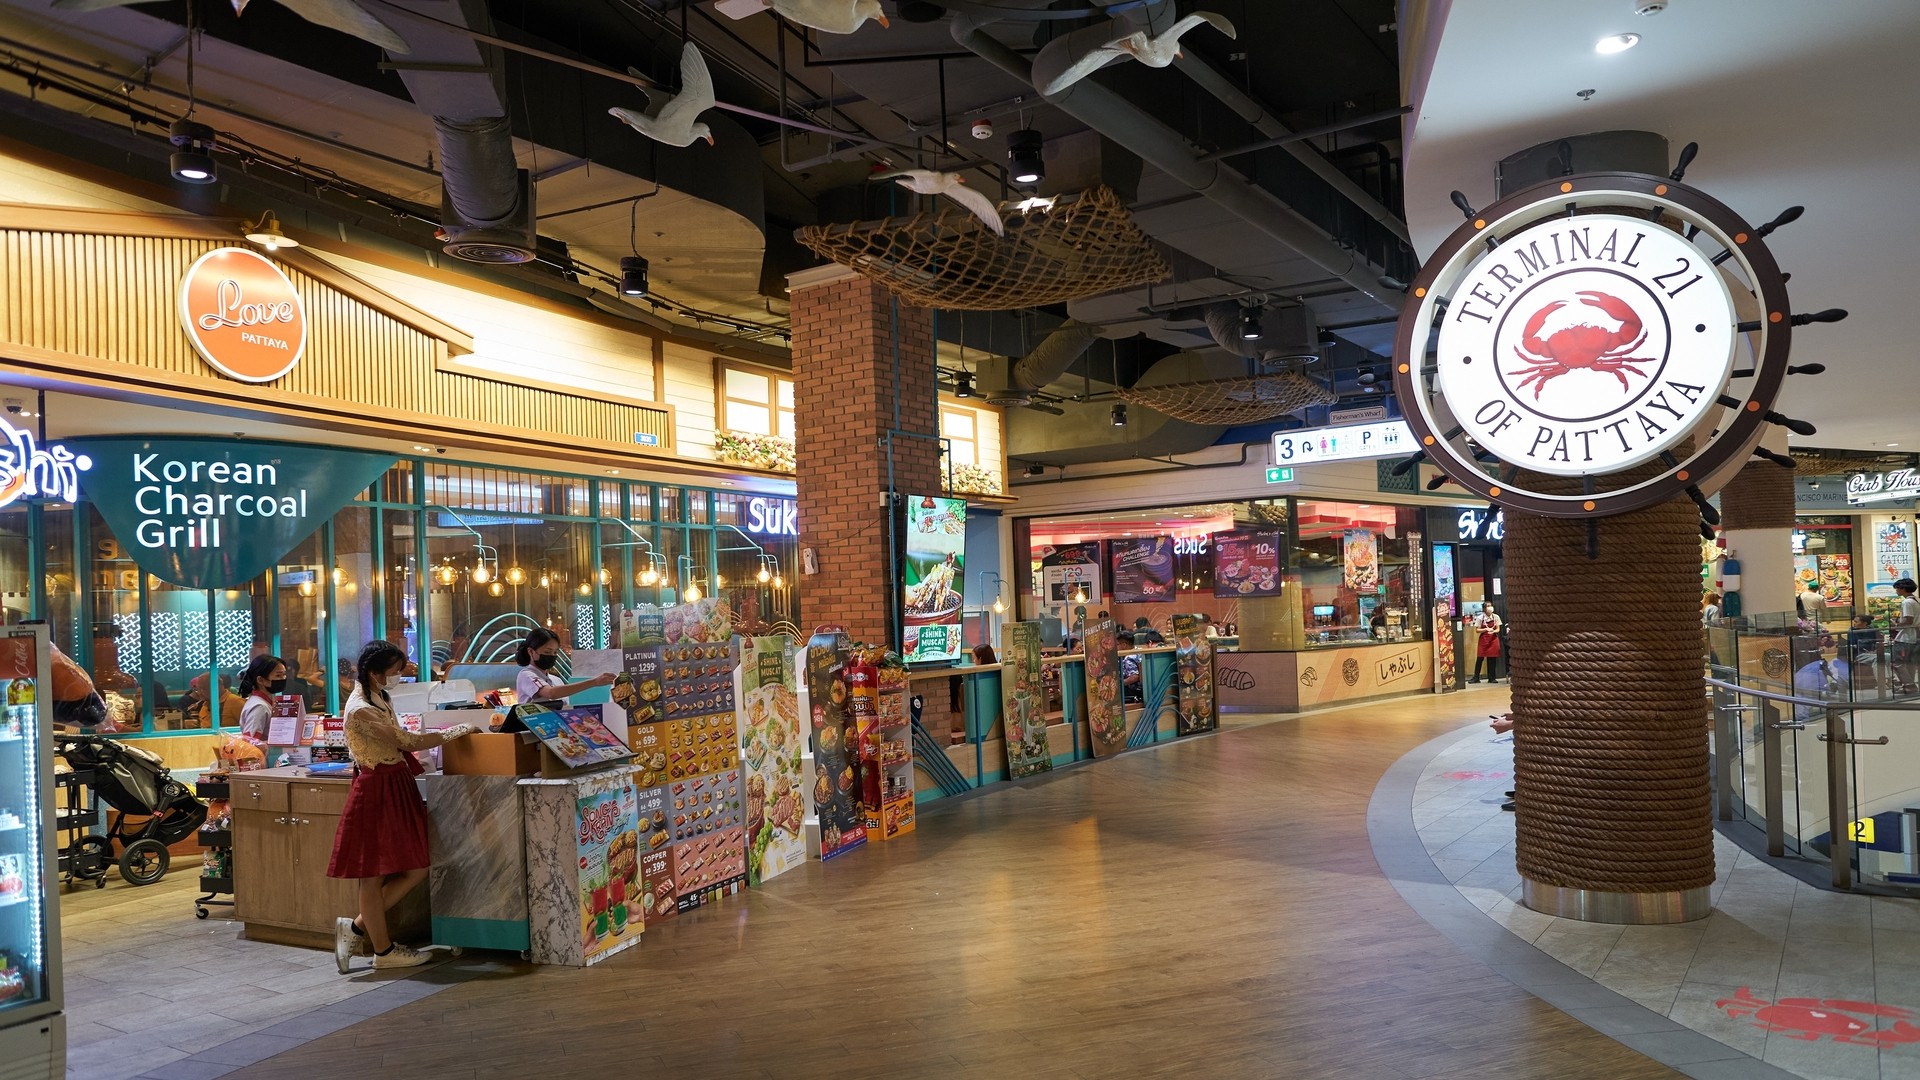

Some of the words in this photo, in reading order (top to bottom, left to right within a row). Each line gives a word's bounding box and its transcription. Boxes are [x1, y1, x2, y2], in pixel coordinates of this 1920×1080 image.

[1456, 227, 1646, 324] TERMINAL
[1652, 257, 1704, 300] 21
[198, 279, 294, 331] Love
[241, 332, 289, 351] PATTAYA
[1332, 411, 1364, 422] Fisherman's
[1365, 409, 1383, 419] Wharf
[1474, 399, 1523, 438] OF
[1527, 380, 1706, 462] PATTAYA
[1362, 431, 1371, 445] P
[1280, 438, 1294, 460] 3
[133, 453, 277, 486] Korean
[1848, 475, 1880, 493] Crab
[134, 485, 307, 518] Charcoal
[136, 518, 220, 548] Grill
[1880, 554, 1909, 565] CATCH
[925, 630, 942, 638] SHINE
[921, 639, 945, 647] MUSCAT
[625, 651, 656, 660] PLATINUM
[1380, 654, 1415, 680] しゃぶし
[637, 726, 655, 735] GOLD
[639, 788, 662, 800] SILVER
[1853, 821, 1866, 838] 2
[643, 850, 667, 864] COPPER
